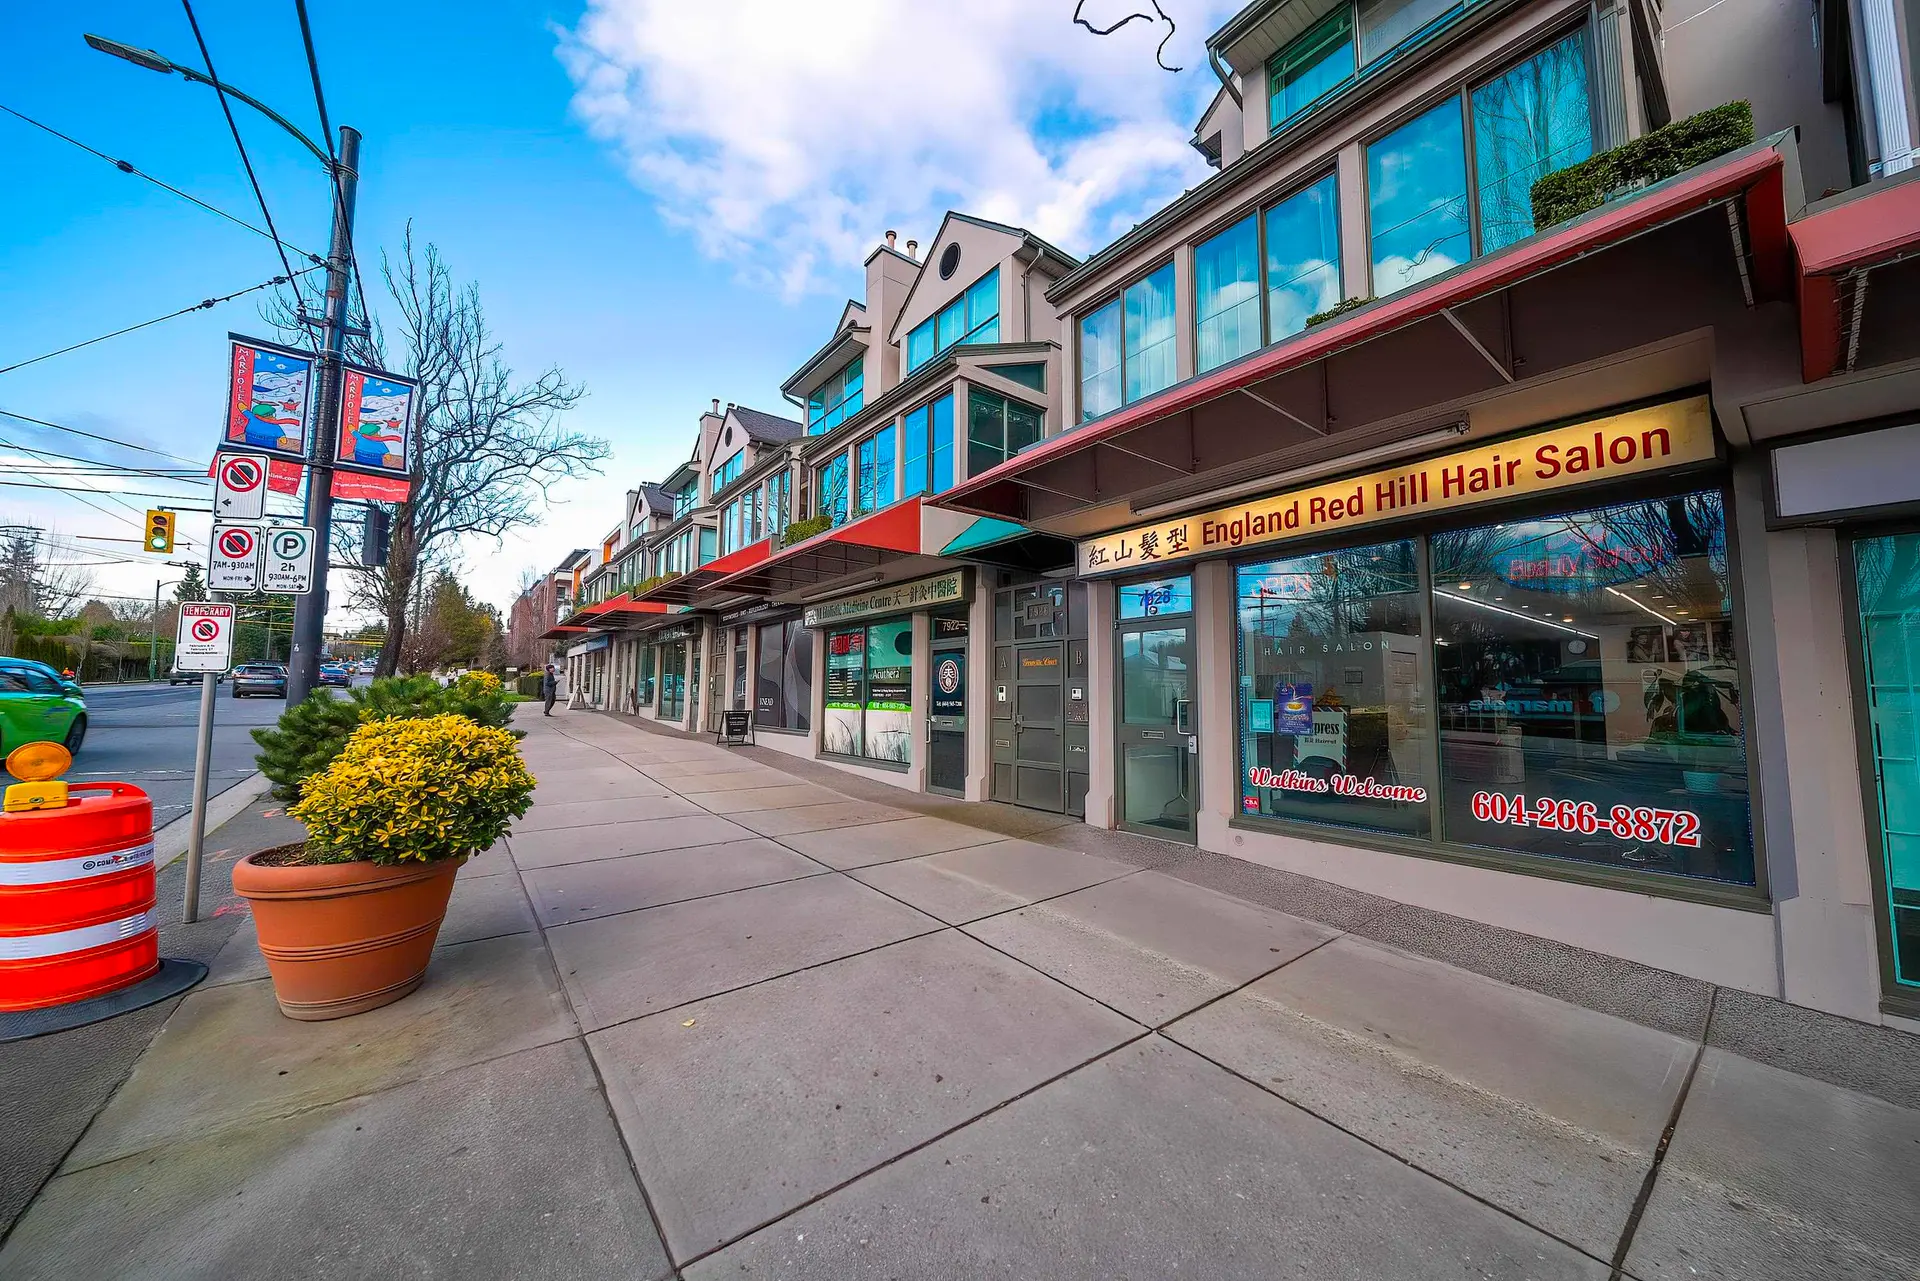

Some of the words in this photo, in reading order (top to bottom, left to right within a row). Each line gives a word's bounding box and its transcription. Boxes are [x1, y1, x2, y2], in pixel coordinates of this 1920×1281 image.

[237, 348, 249, 401] MARPOLE
[347, 373, 359, 423] MARPOLE
[1202, 501, 1299, 545] England
[1310, 487, 1363, 525] Red
[1375, 472, 1429, 512] Hill
[1442, 455, 1522, 498] Hair
[1535, 427, 1671, 479] Salon
[1089, 524, 1190, 568] 紅山髮型
[280, 562, 295, 572] 2h
[869, 594, 892, 610] Centre
[893, 577, 958, 606] 天一針灸中醫院
[184, 605, 230, 617] TEMPORARY
[942, 620, 960, 632] 7922
[1075, 651, 1083, 665] B
[1264, 646, 1306, 656] HAIR
[1322, 640, 1389, 653] SALON
[1249, 766, 1330, 793] Walkins
[1330, 773, 1427, 803] Welcome
[1472, 790, 1702, 848] 604-266-8872
